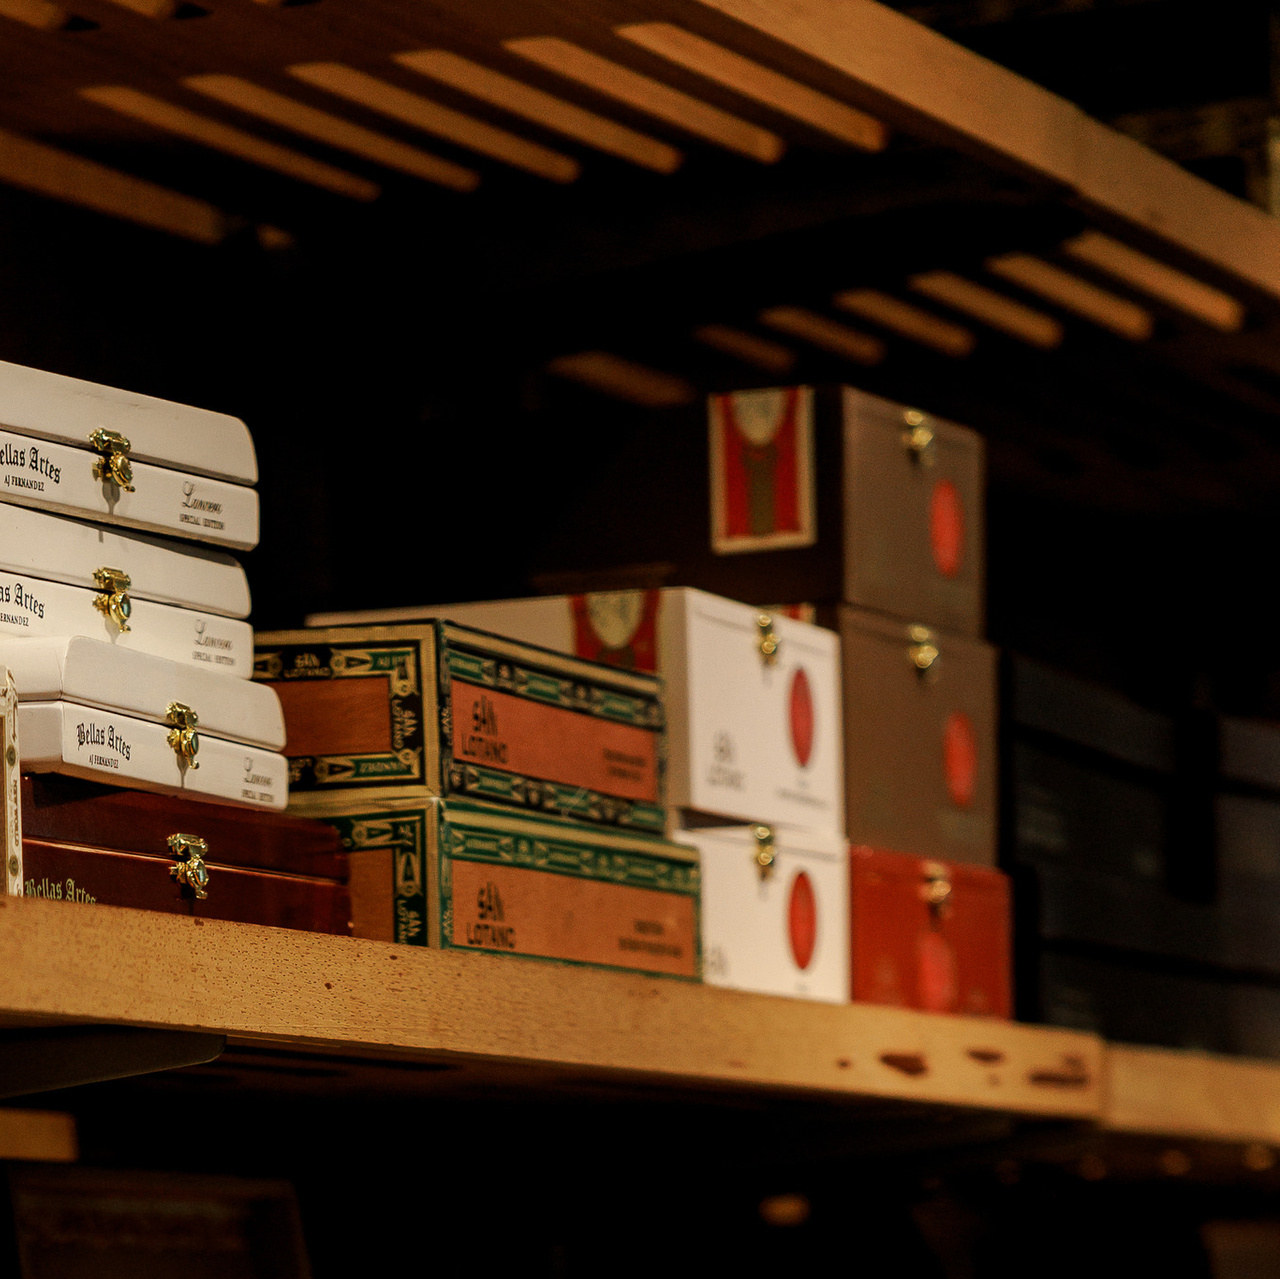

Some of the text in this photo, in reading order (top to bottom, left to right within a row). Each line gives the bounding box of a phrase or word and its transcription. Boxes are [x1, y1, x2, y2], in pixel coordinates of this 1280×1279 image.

[28, 446, 62, 484] Artes
[4, 475, 45, 492] AJ FERNANDEZ
[13, 582, 45, 619] Artes
[76, 722, 132, 761] Bellas Artes
[94, 754, 119, 770] FERNANDEZ
[24, 877, 97, 905] Bellas Artes
